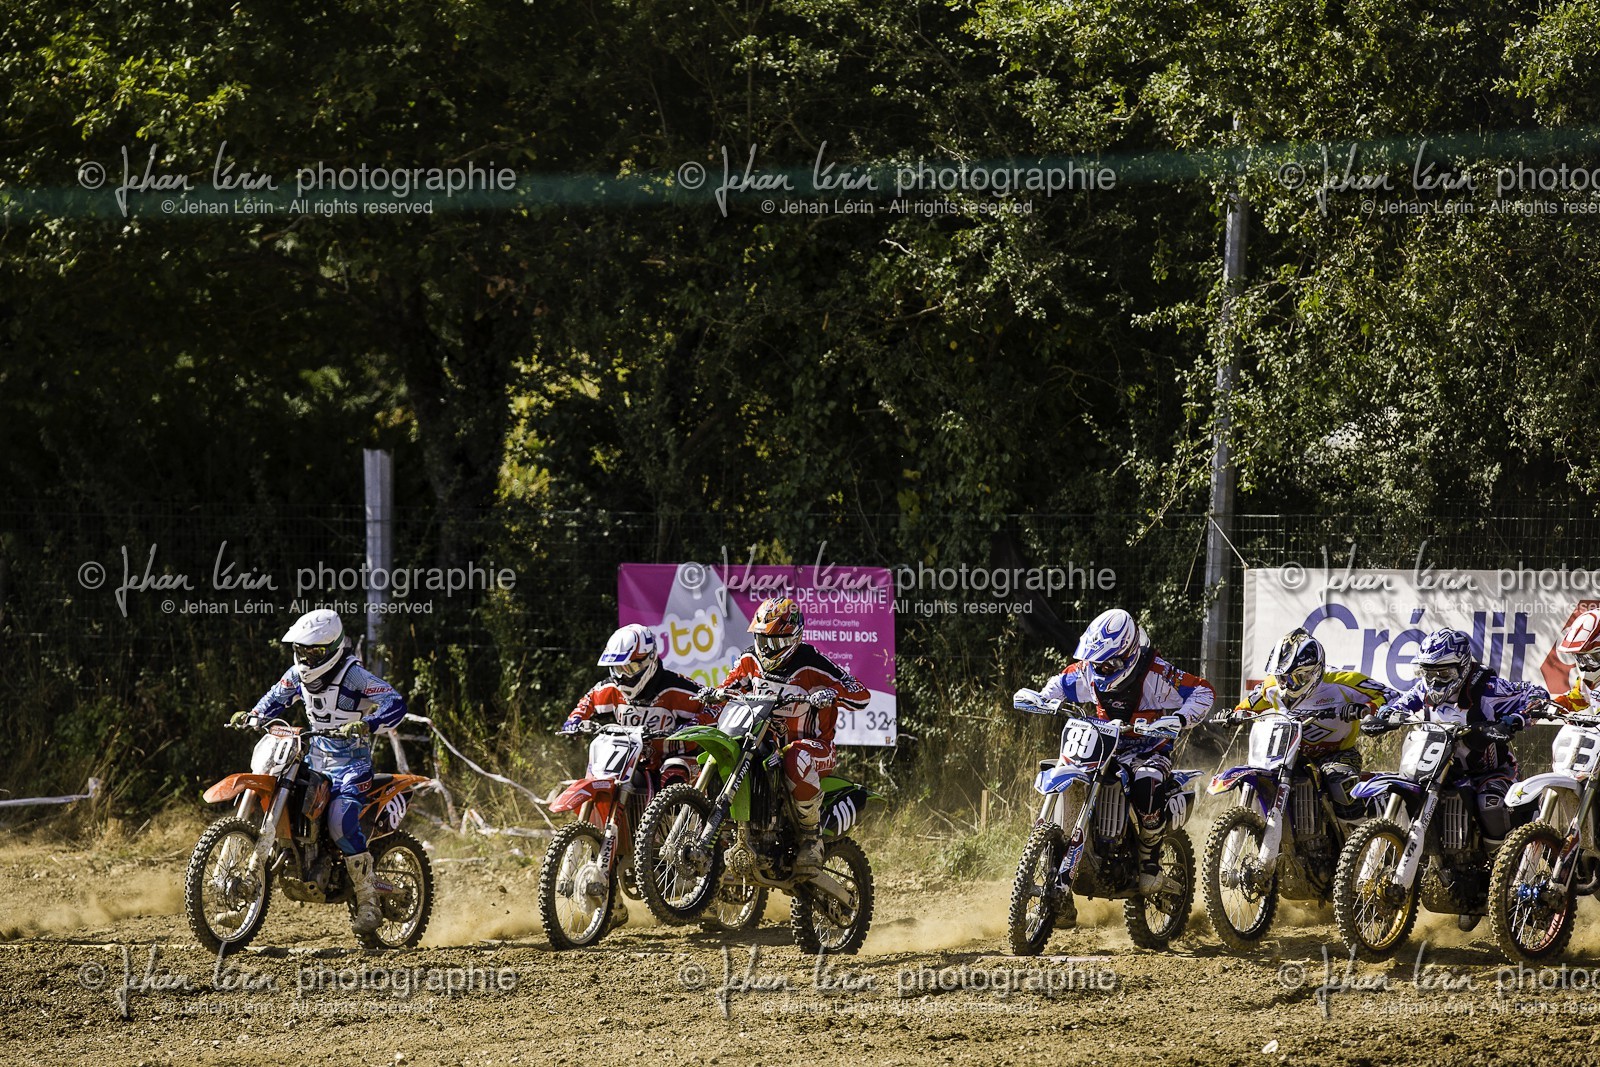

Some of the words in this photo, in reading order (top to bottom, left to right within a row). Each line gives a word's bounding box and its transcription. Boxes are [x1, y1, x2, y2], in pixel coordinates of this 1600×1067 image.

[797, 588, 814, 602] DE
[817, 588, 886, 604] CONDUITE
[807, 618, 831, 626] Général
[655, 613, 718, 659] uto'
[839, 630, 852, 642] DU
[854, 631, 878, 643] BOIS
[828, 651, 853, 660] Calvaire
[720, 704, 764, 730] 101
[866, 710, 889, 731] 32
[1063, 727, 1099, 759] 89
[386, 791, 407, 830] 80
[833, 795, 857, 836] 101
[1169, 794, 1187, 831] 89
